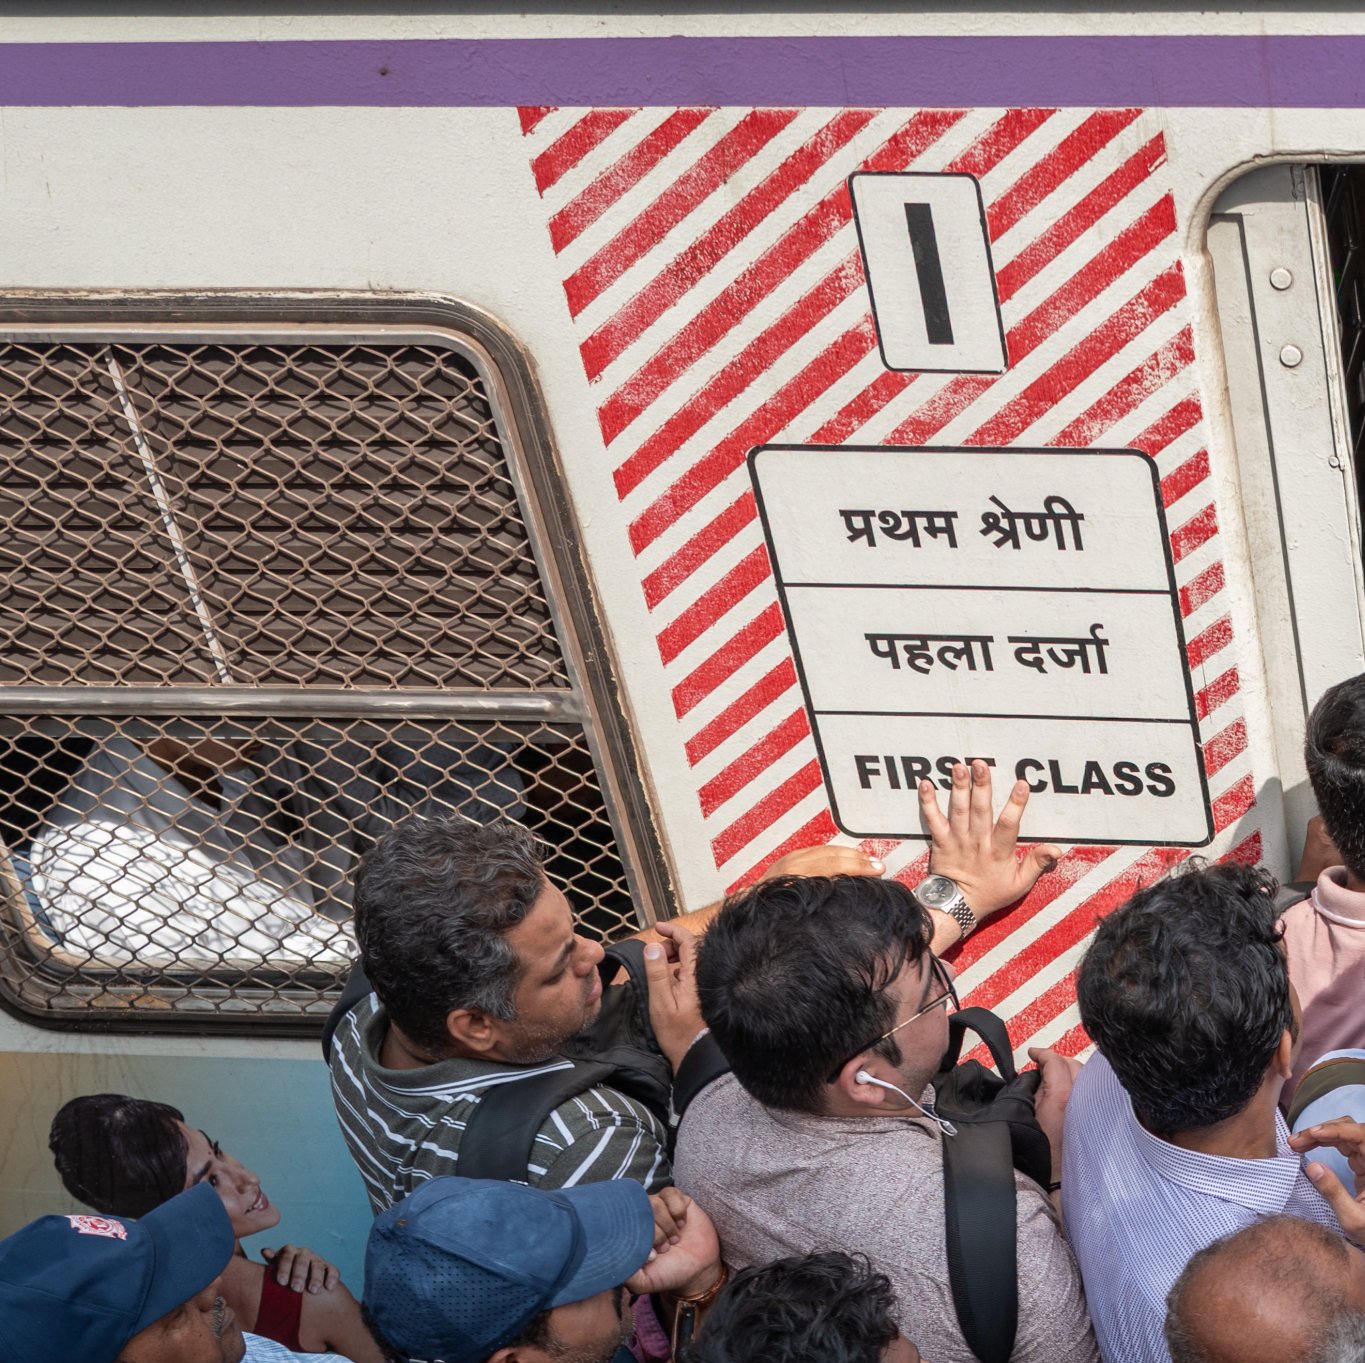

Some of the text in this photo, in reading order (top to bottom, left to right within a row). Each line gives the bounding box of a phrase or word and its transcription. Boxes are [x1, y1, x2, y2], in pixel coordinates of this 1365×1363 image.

[838, 495, 1085, 551] प्रथम श्रेणी
[864, 623, 1110, 675] पहला दर्जा
[1015, 758, 1176, 798] CLASS
